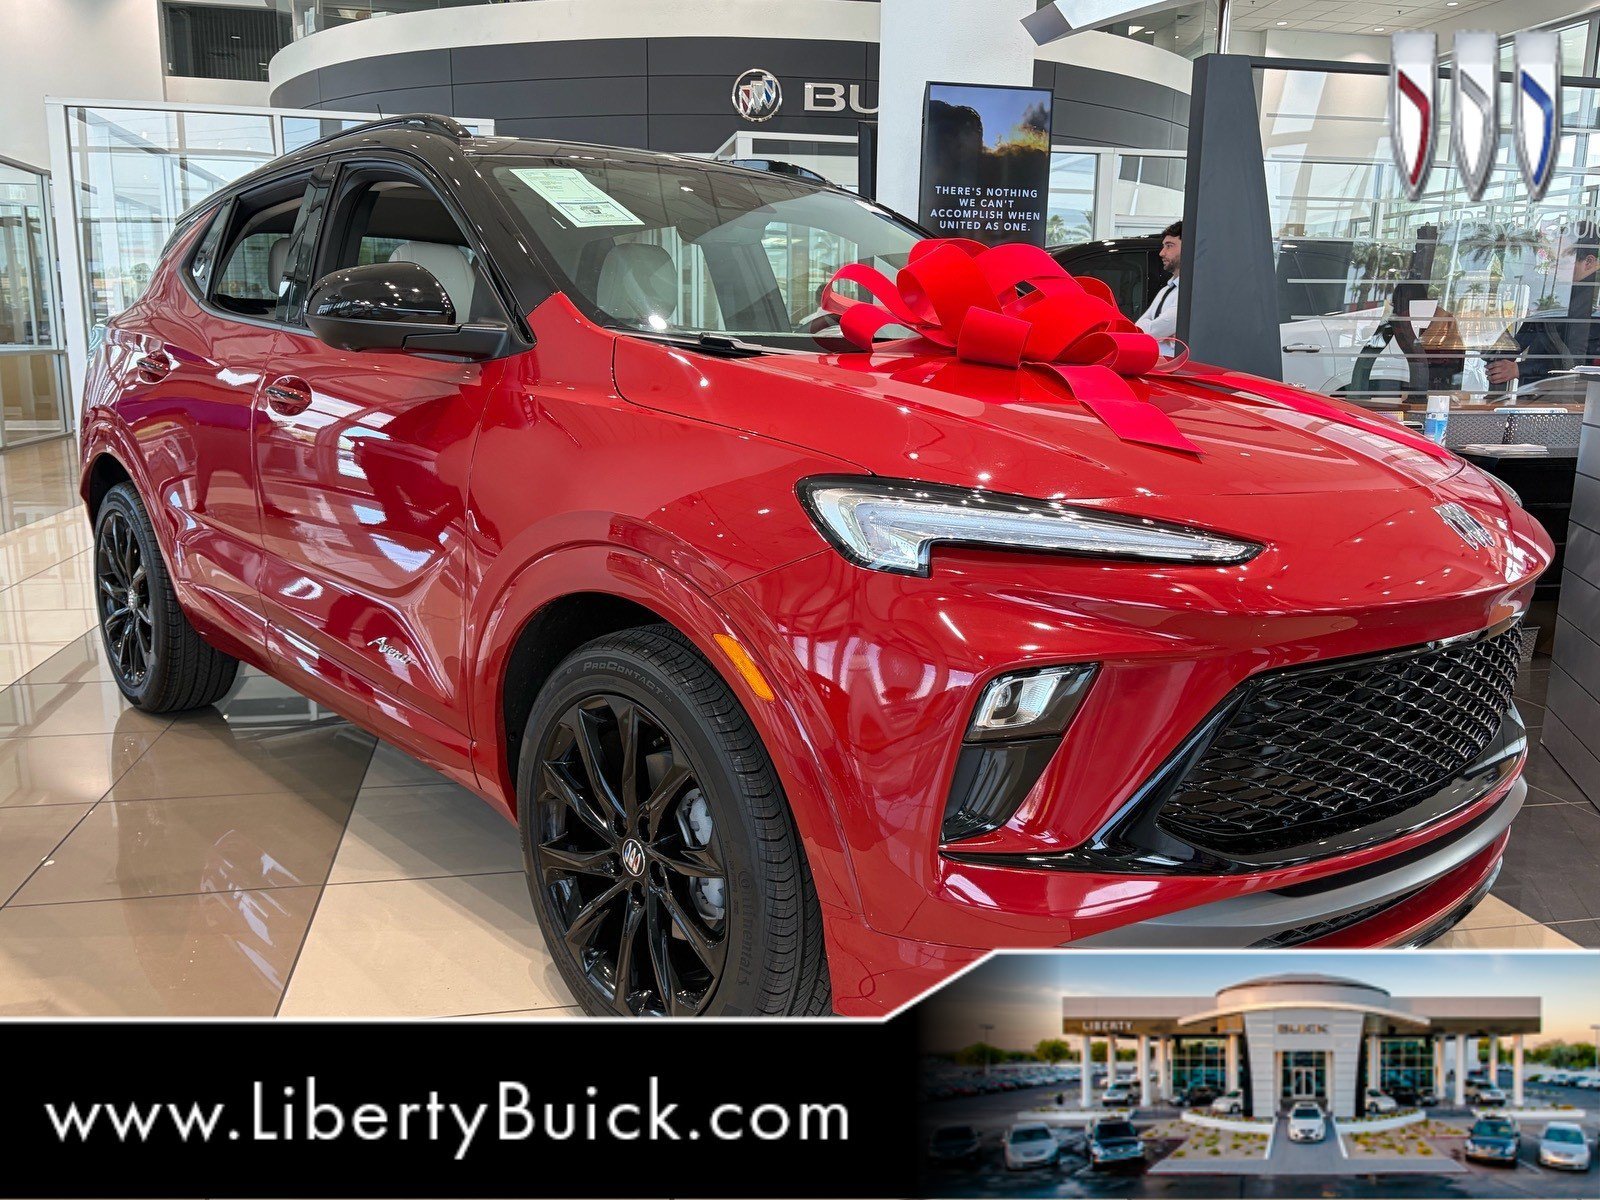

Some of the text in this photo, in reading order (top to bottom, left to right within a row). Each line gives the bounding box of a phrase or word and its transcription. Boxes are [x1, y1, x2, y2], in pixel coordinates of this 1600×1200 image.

[935, 185, 1038, 198] THERE'S NOTHING
[959, 198, 1014, 208] WE CAN'T
[930, 209, 1040, 221] ACCOMPLISH WHEN
[940, 220, 1031, 231] UNITED AS ONE.
